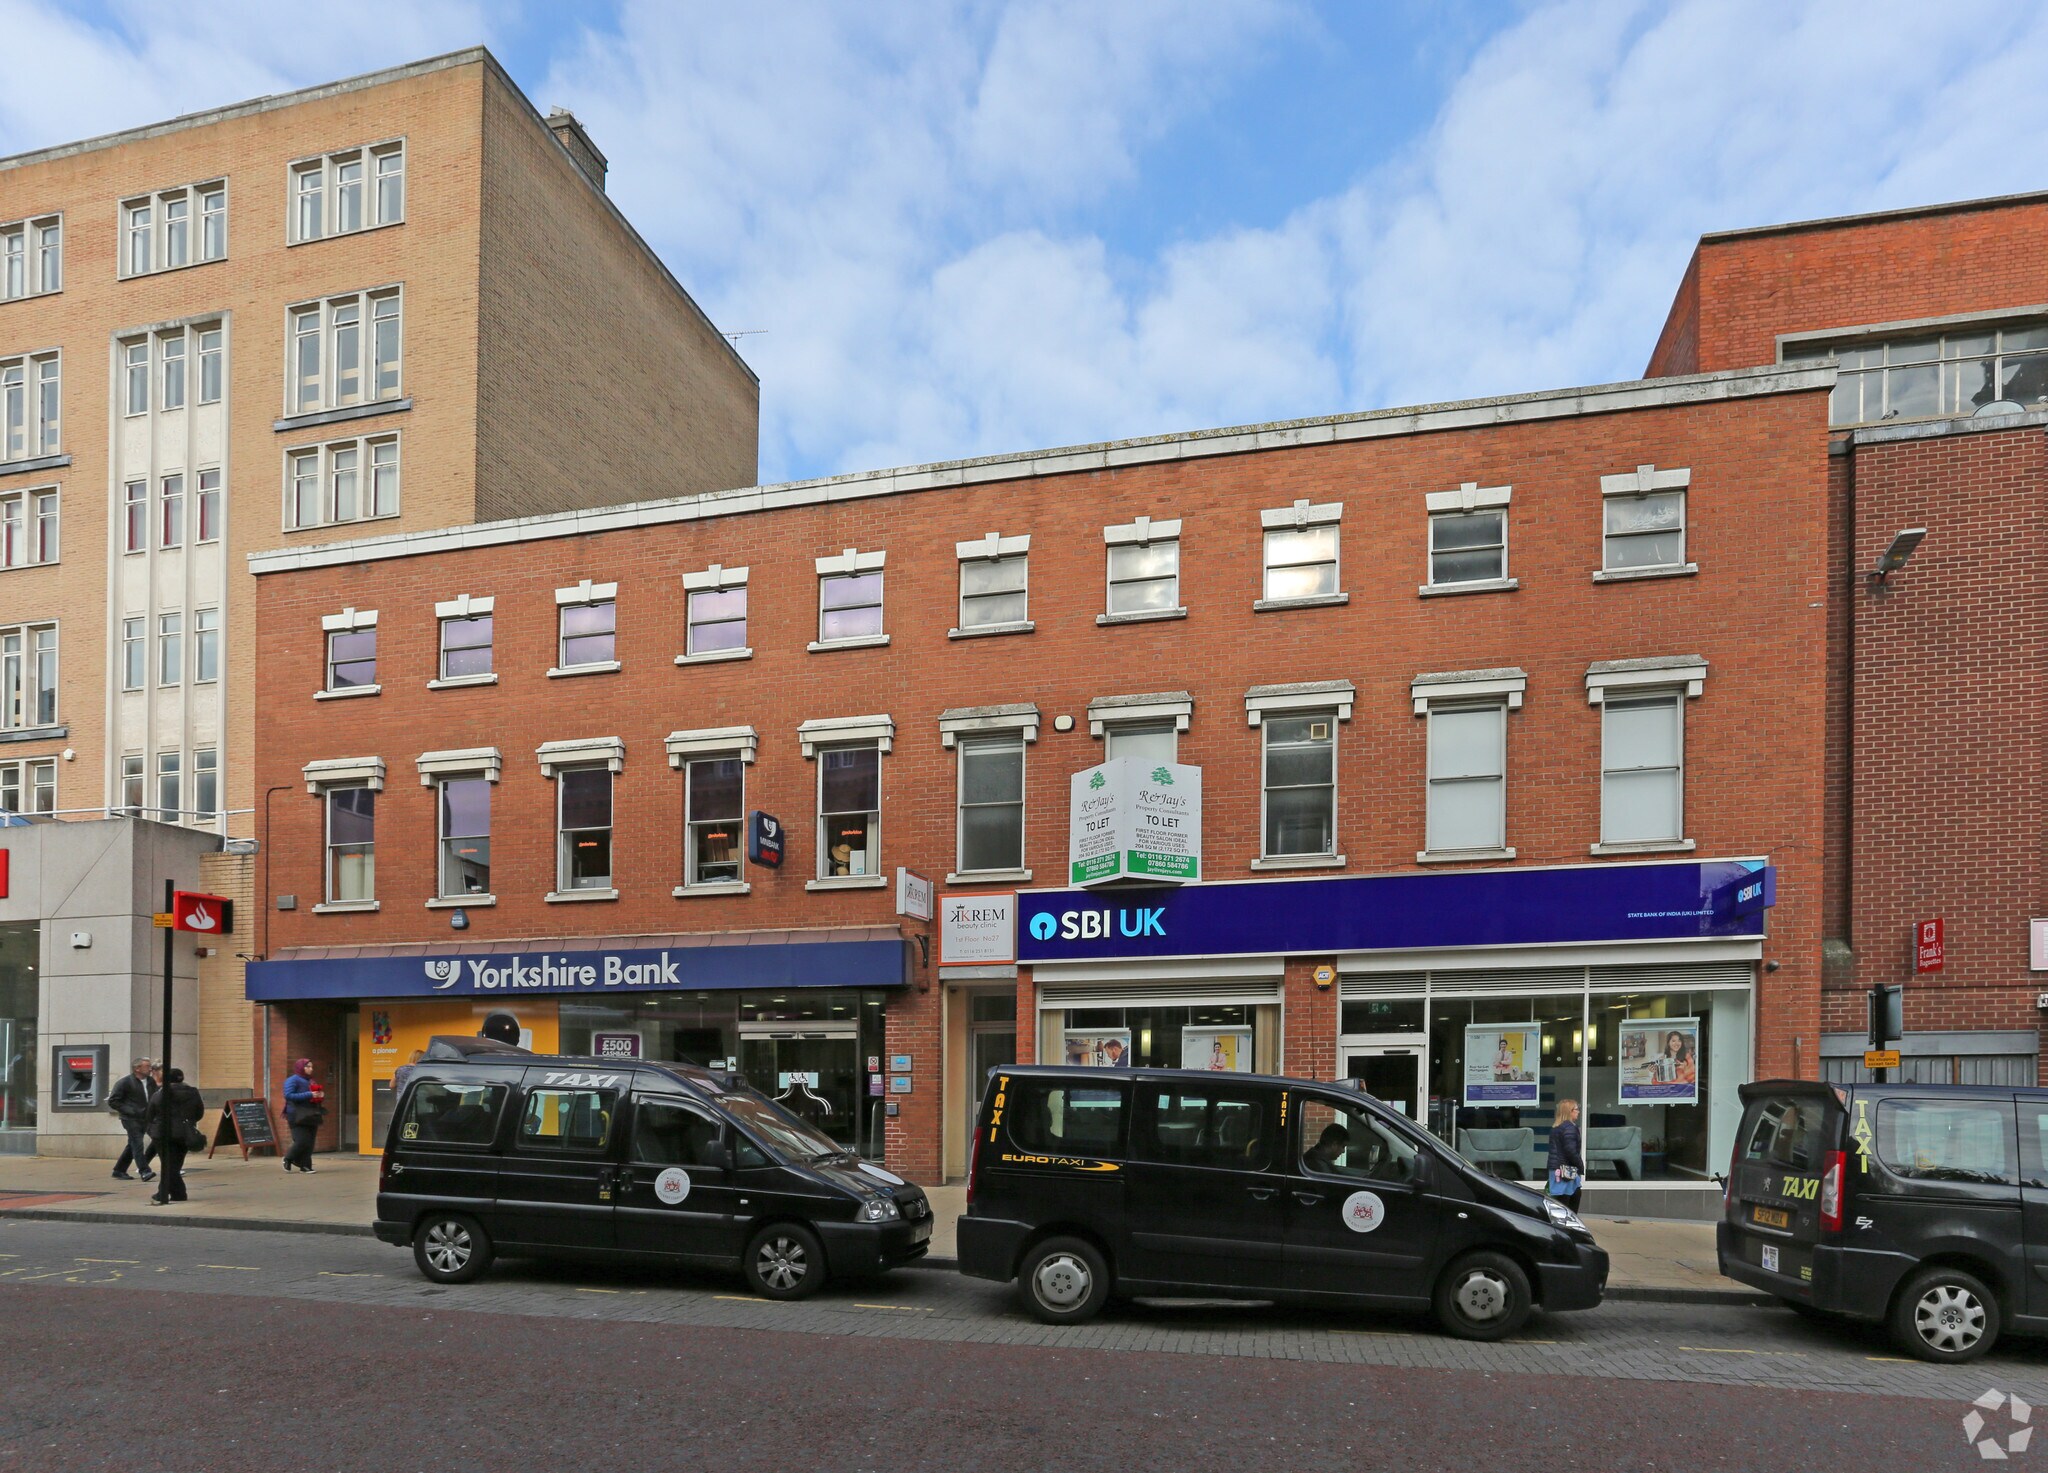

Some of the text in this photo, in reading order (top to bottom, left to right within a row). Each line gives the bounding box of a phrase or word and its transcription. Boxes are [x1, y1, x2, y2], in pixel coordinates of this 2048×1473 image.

[1086, 817, 1110, 832] TO LET
[1146, 814, 1180, 828] TO LET
[1147, 853, 1163, 861] 0116
[1163, 854, 1174, 862] 271
[1743, 881, 1762, 901] SBI UK
[956, 922, 980, 930] beauty
[1061, 907, 1166, 940] SBI UK
[1919, 942, 1942, 960] Frank's
[467, 951, 681, 989] Yorkshire Bank
[1919, 958, 1942, 968] Baguettes
[376, 1047, 398, 1055] pioneer
[602, 1040, 632, 1051] £500
[543, 1072, 620, 1088] TAXI
[990, 1076, 1009, 1143] TAXI
[1280, 1092, 1288, 1126] TAXI
[1854, 1100, 1872, 1174] TAXI
[1001, 1154, 1084, 1166] EUROTAXI
[1782, 1176, 1820, 1200] TAXI
